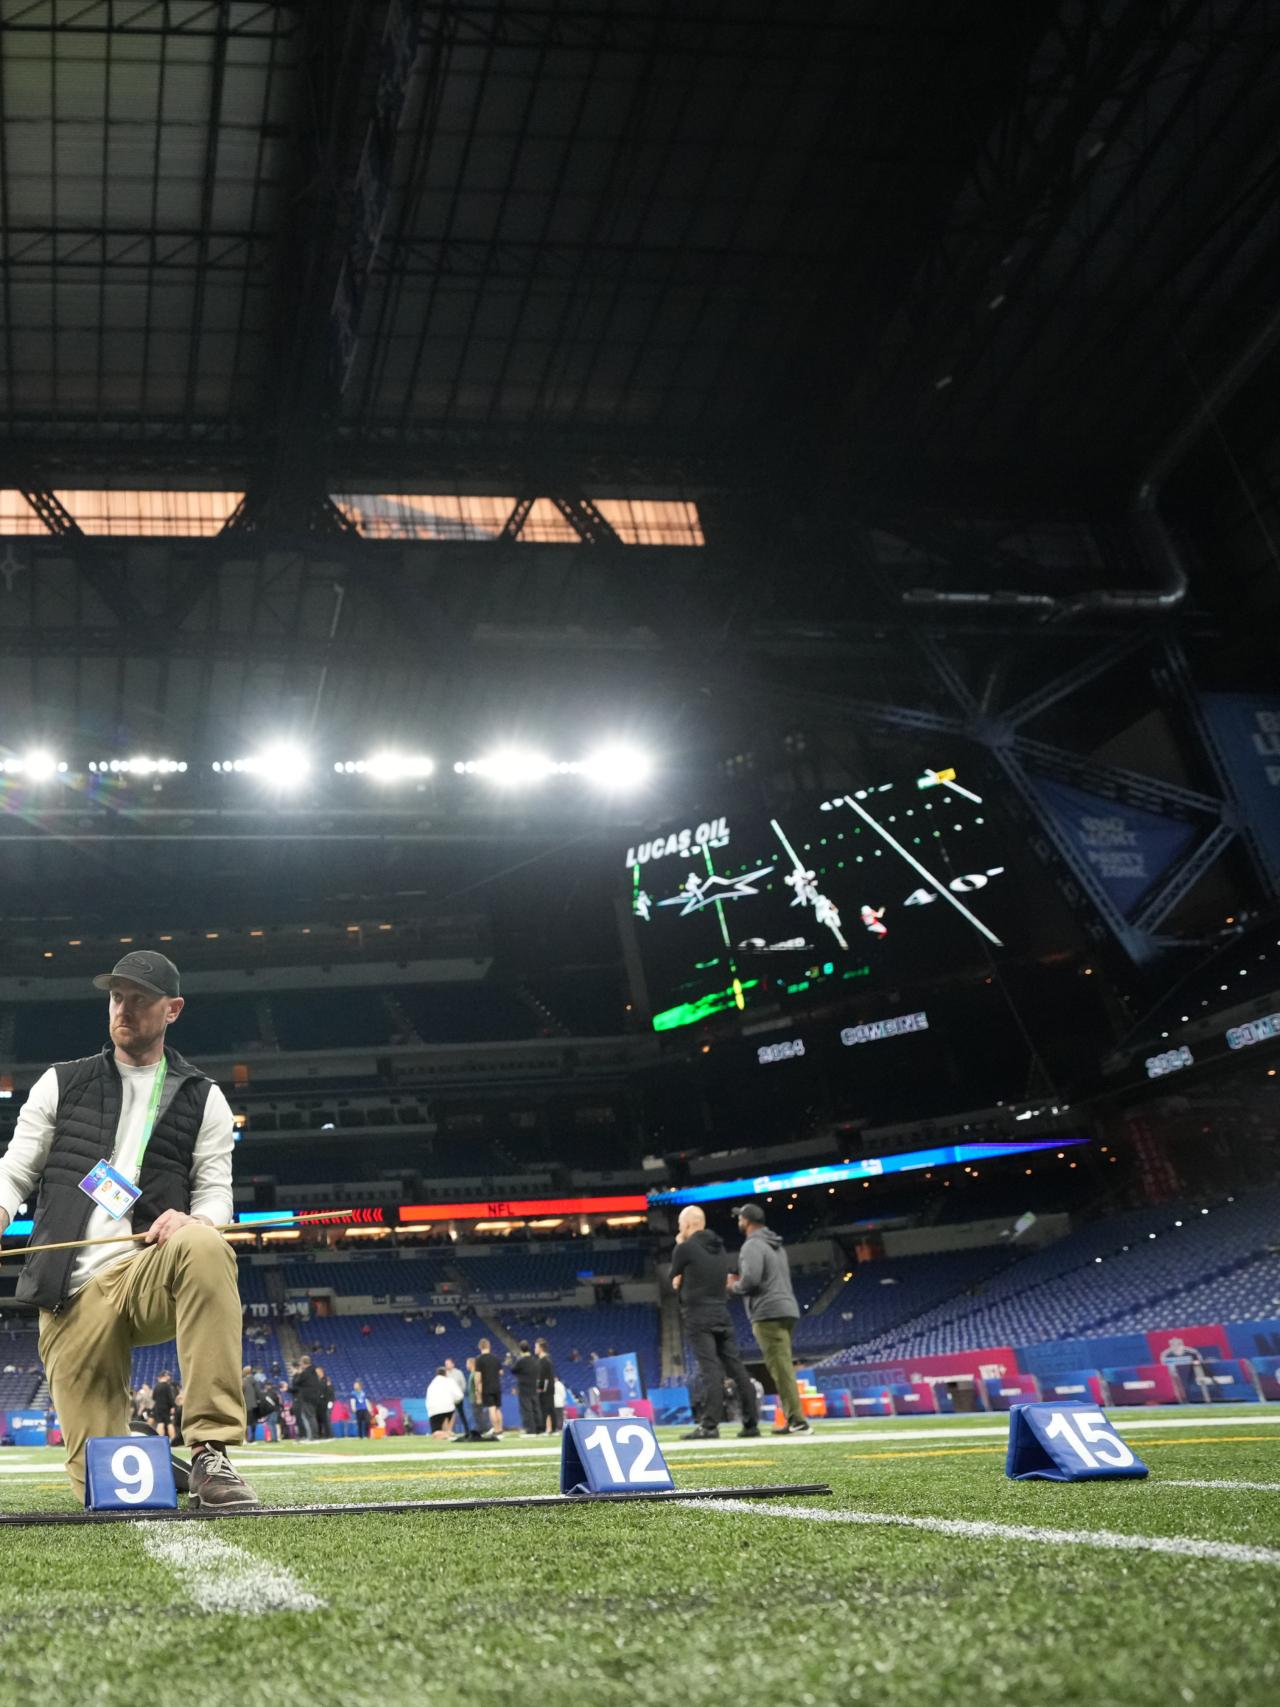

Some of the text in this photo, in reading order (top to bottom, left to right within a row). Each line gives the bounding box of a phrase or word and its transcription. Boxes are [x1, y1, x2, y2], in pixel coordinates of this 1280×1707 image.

[626, 816, 730, 868] LUCAS OIL
[840, 1011, 929, 1046] COMBINE
[488, 1202, 516, 1216] NFL
[584, 1424, 671, 1483] 12
[1044, 1411, 1135, 1468] 15
[110, 1445, 155, 1504] 9
